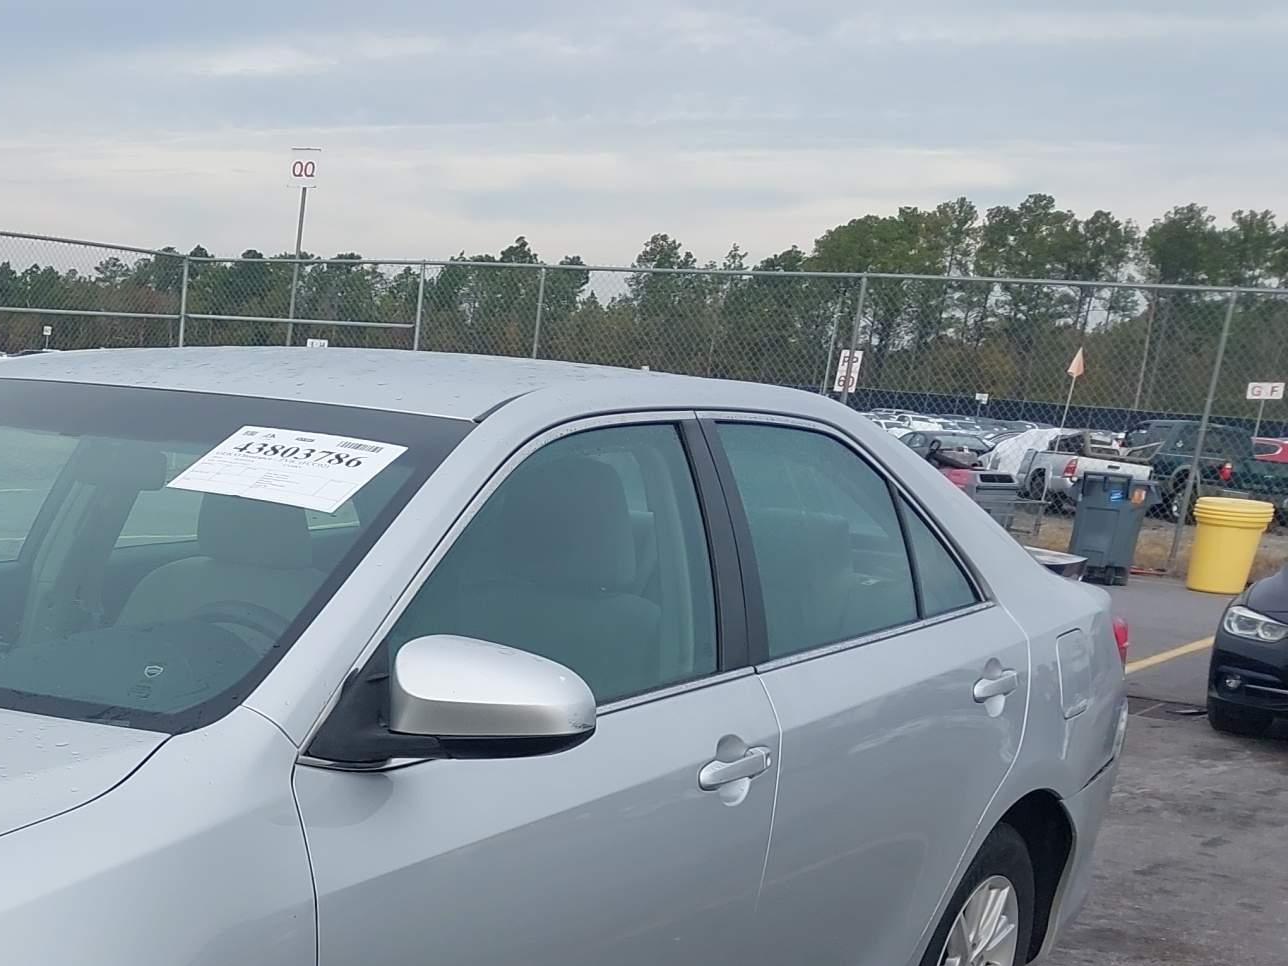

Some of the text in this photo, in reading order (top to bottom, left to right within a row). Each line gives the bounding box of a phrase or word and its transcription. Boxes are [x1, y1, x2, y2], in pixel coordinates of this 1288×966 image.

[292, 161, 315, 178] QQ
[1270, 385, 1280, 397] F
[233, 441, 368, 468] 43803786
